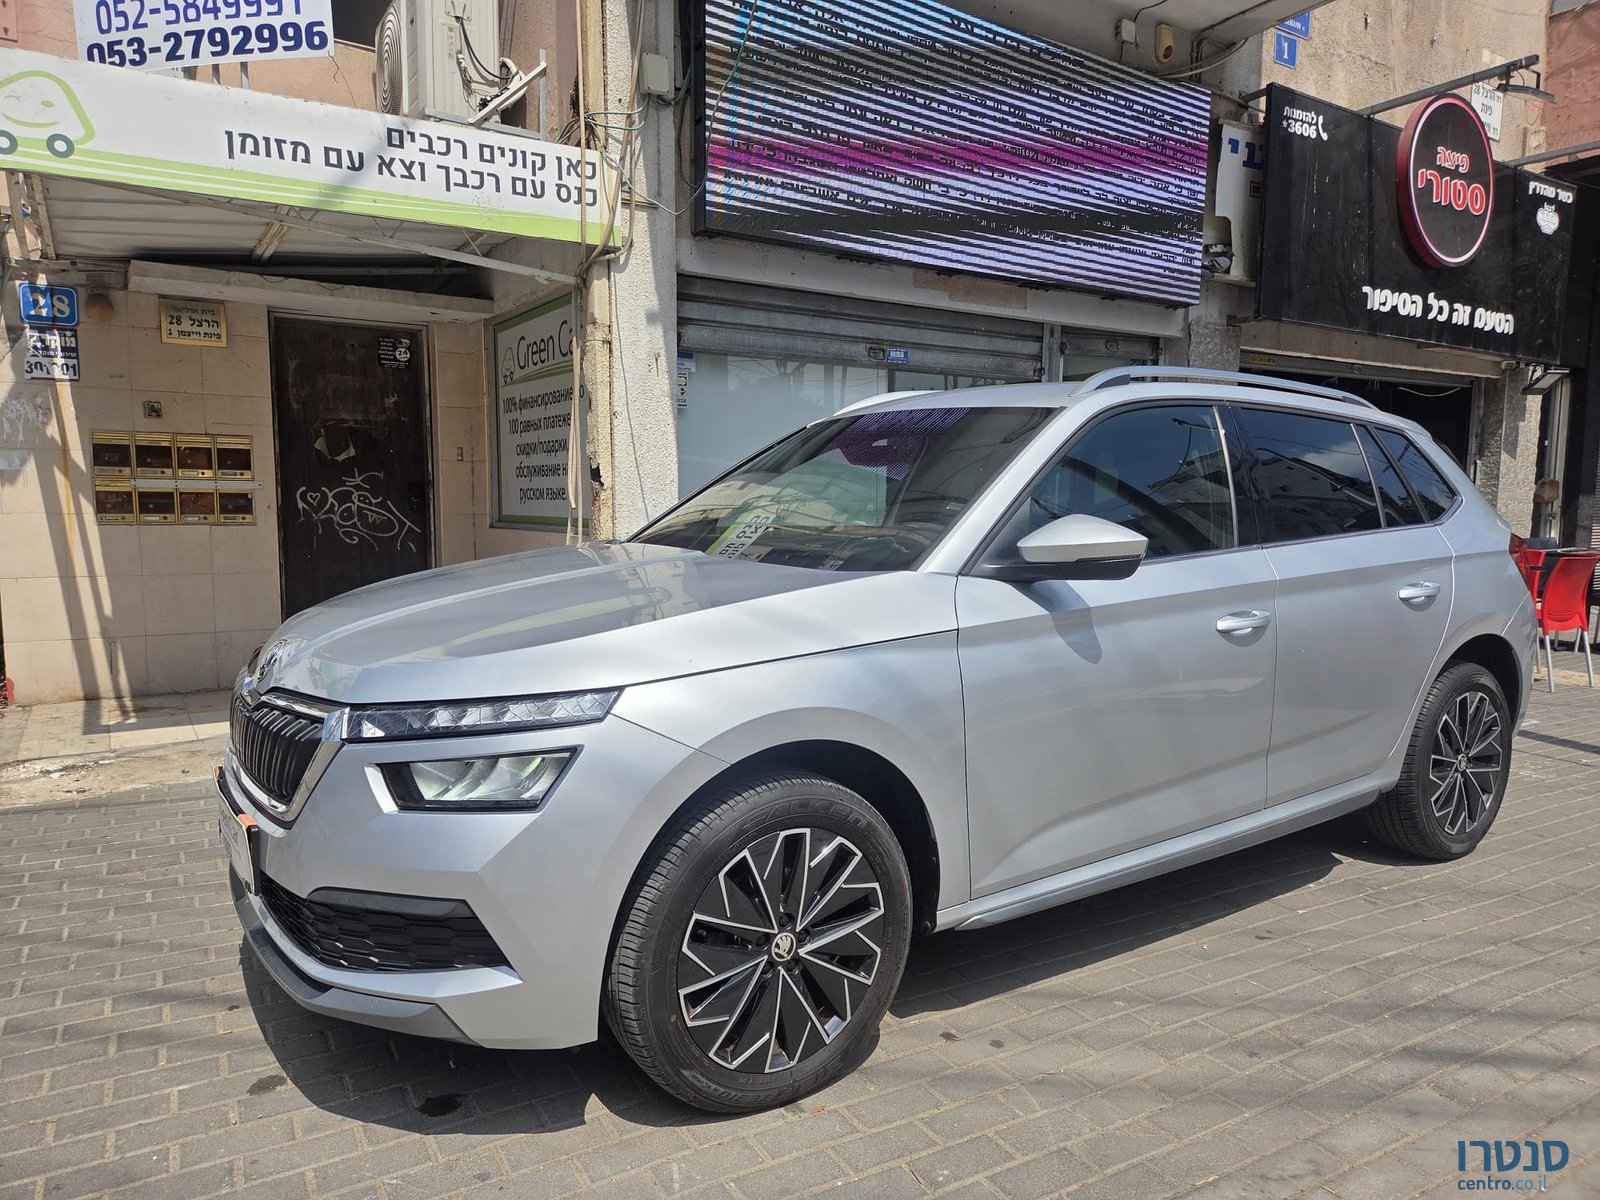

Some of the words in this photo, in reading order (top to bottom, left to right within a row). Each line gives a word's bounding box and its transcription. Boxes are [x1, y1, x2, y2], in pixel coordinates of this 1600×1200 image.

[86, 20, 329, 68] 053-2792996
[1282, 41, 1288, 60] 1
[1283, 106, 1317, 124] להזמנות
[224, 129, 311, 165] מזומן
[386, 127, 468, 160] רכבים
[323, 144, 364, 172] עם
[377, 154, 426, 182] וצא
[478, 142, 547, 177] קונים
[556, 155, 597, 181] כאן
[1436, 146, 1470, 174] פיצה
[436, 164, 501, 193] רכבך
[511, 175, 546, 200] עם
[1417, 168, 1486, 216] סטורי
[554, 182, 597, 208] כנס
[29, 292, 71, 318] 28
[1361, 285, 1424, 318] הסיפור
[1427, 292, 1450, 323] כל
[1451, 302, 1472, 327] זה
[168, 314, 183, 326] 28
[189, 315, 219, 329] הרצל
[1473, 307, 1515, 335] הטעם
[517, 335, 555, 370] Green
[503, 396, 518, 415] 100%
[519, 386, 574, 415] финансирование
[509, 418, 519, 435] 100
[520, 415, 543, 437] равных
[544, 412, 572, 430] платеже
[515, 461, 561, 483] обслуживание
[520, 488, 545, 505] русском
